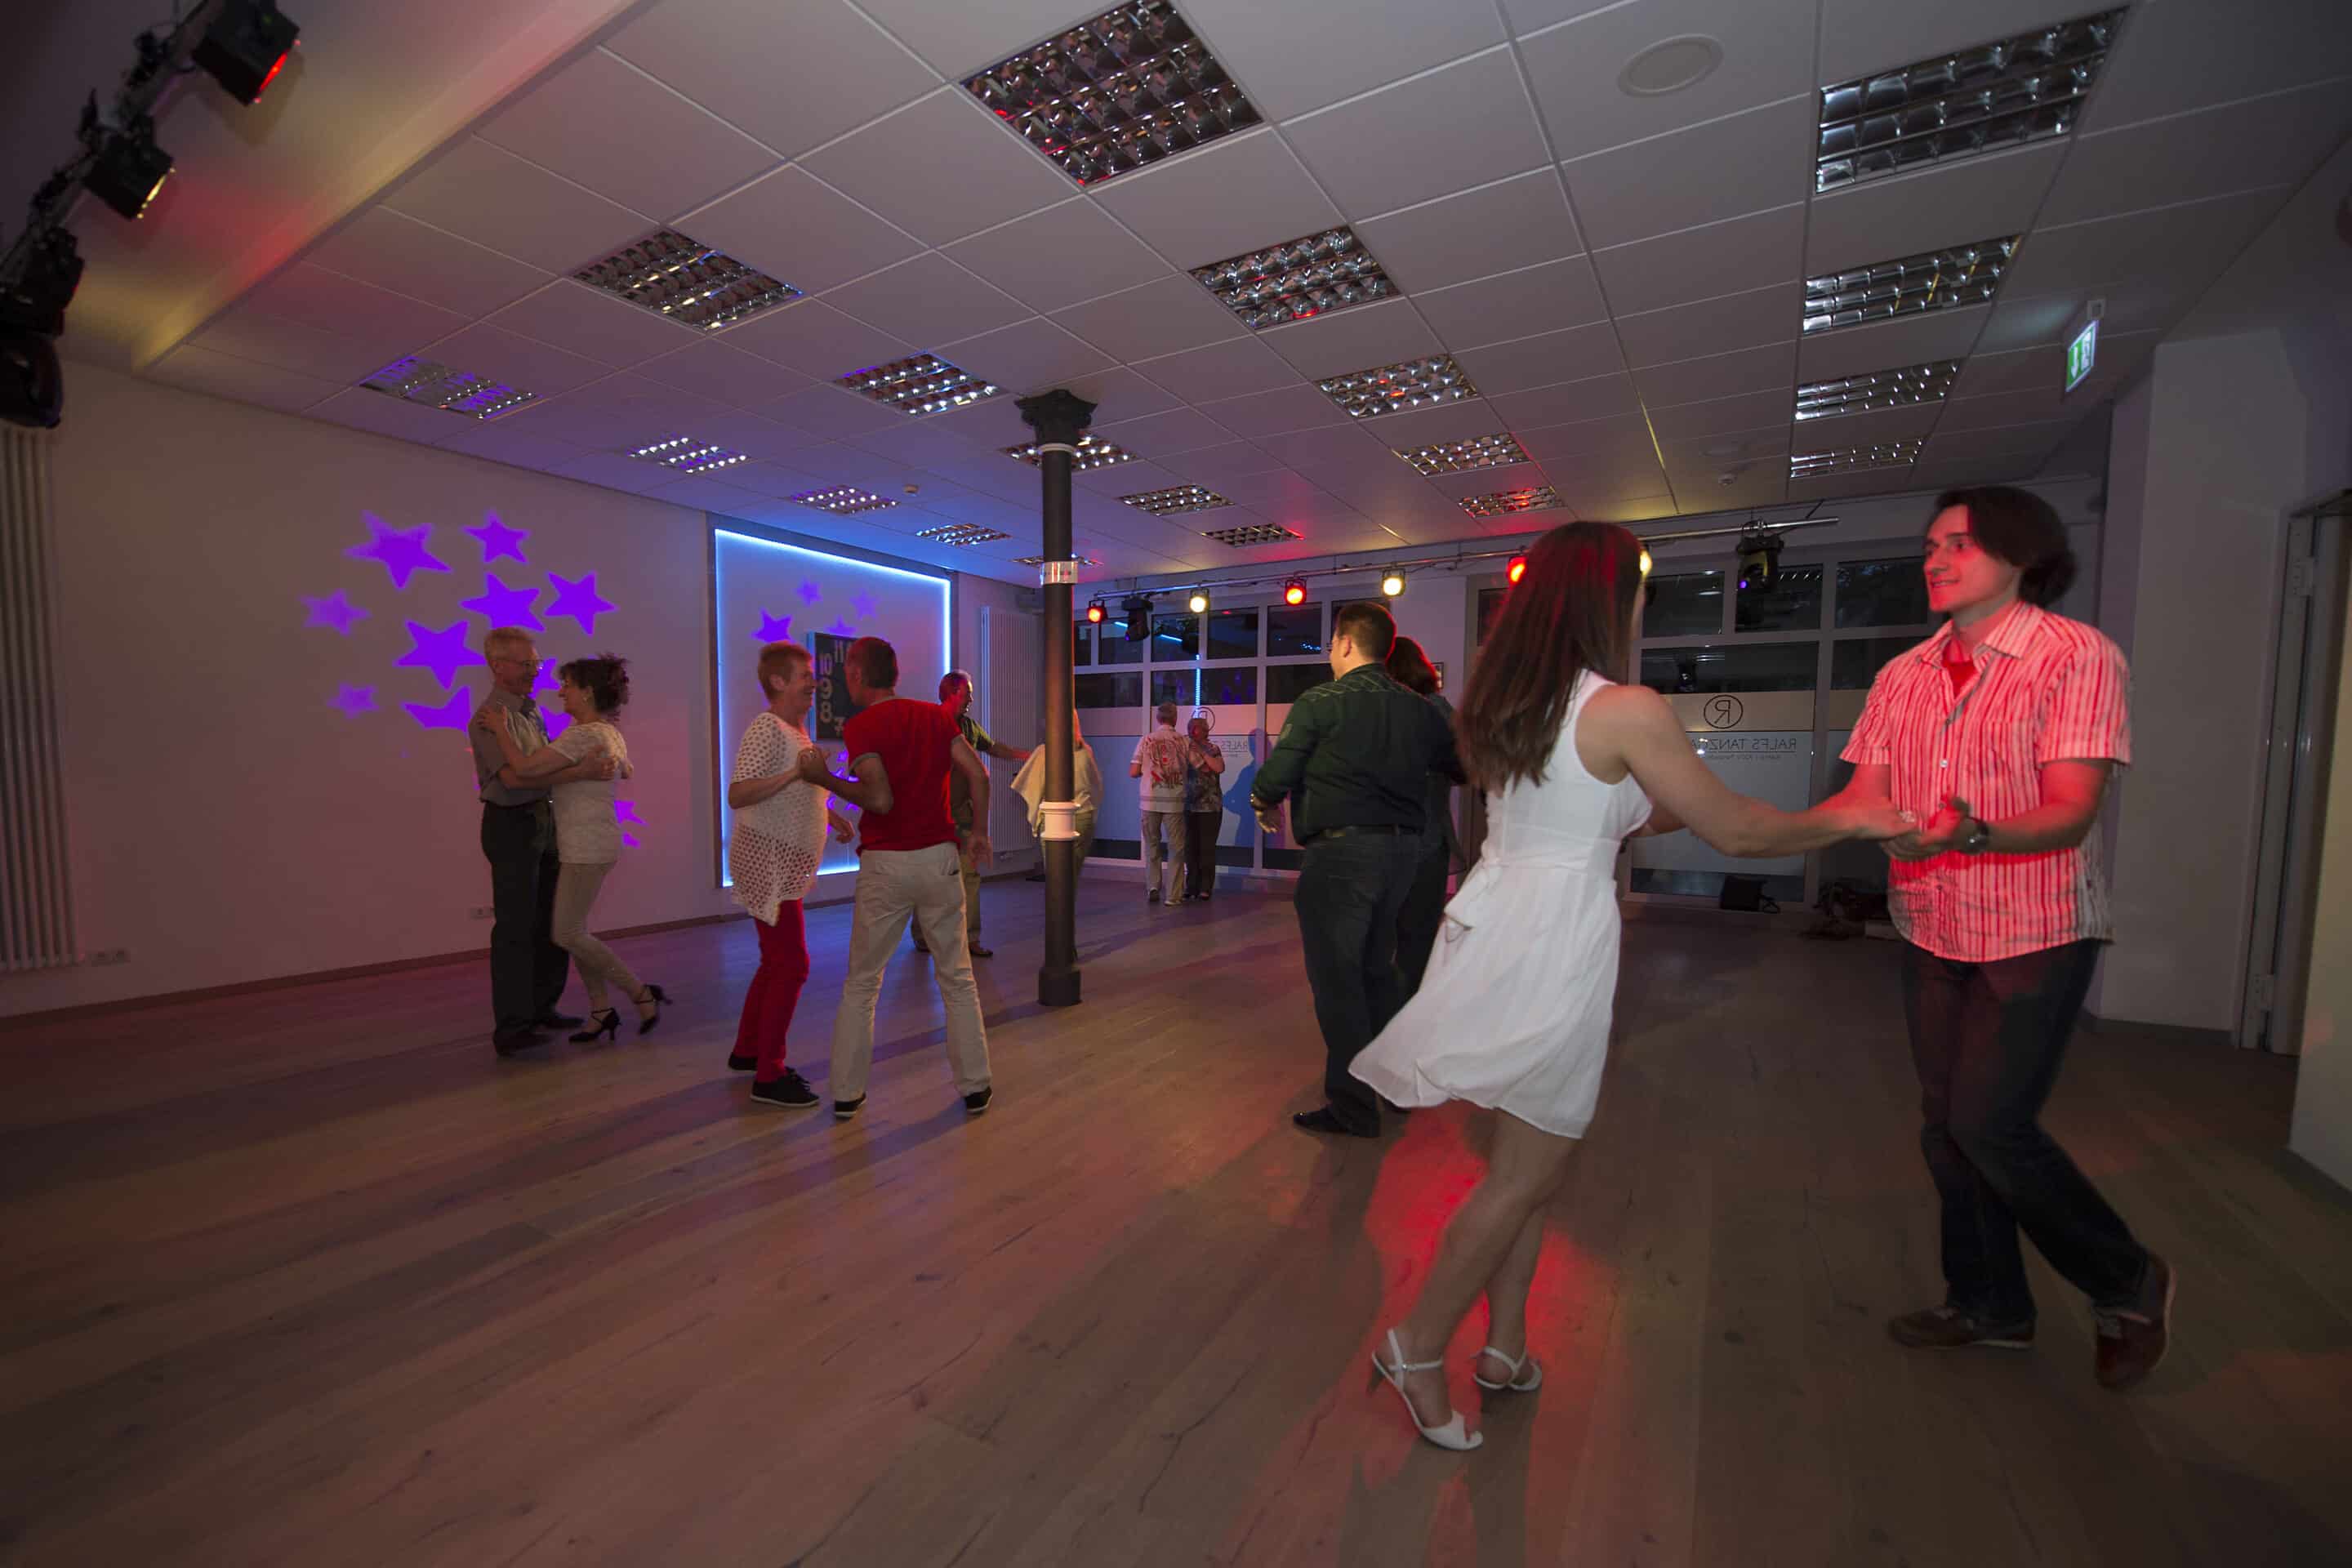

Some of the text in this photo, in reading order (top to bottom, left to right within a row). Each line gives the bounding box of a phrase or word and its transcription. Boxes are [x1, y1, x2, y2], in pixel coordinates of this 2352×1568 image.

[820, 653, 832, 675] 10
[821, 677, 832, 699] 9
[821, 701, 831, 723] 8
